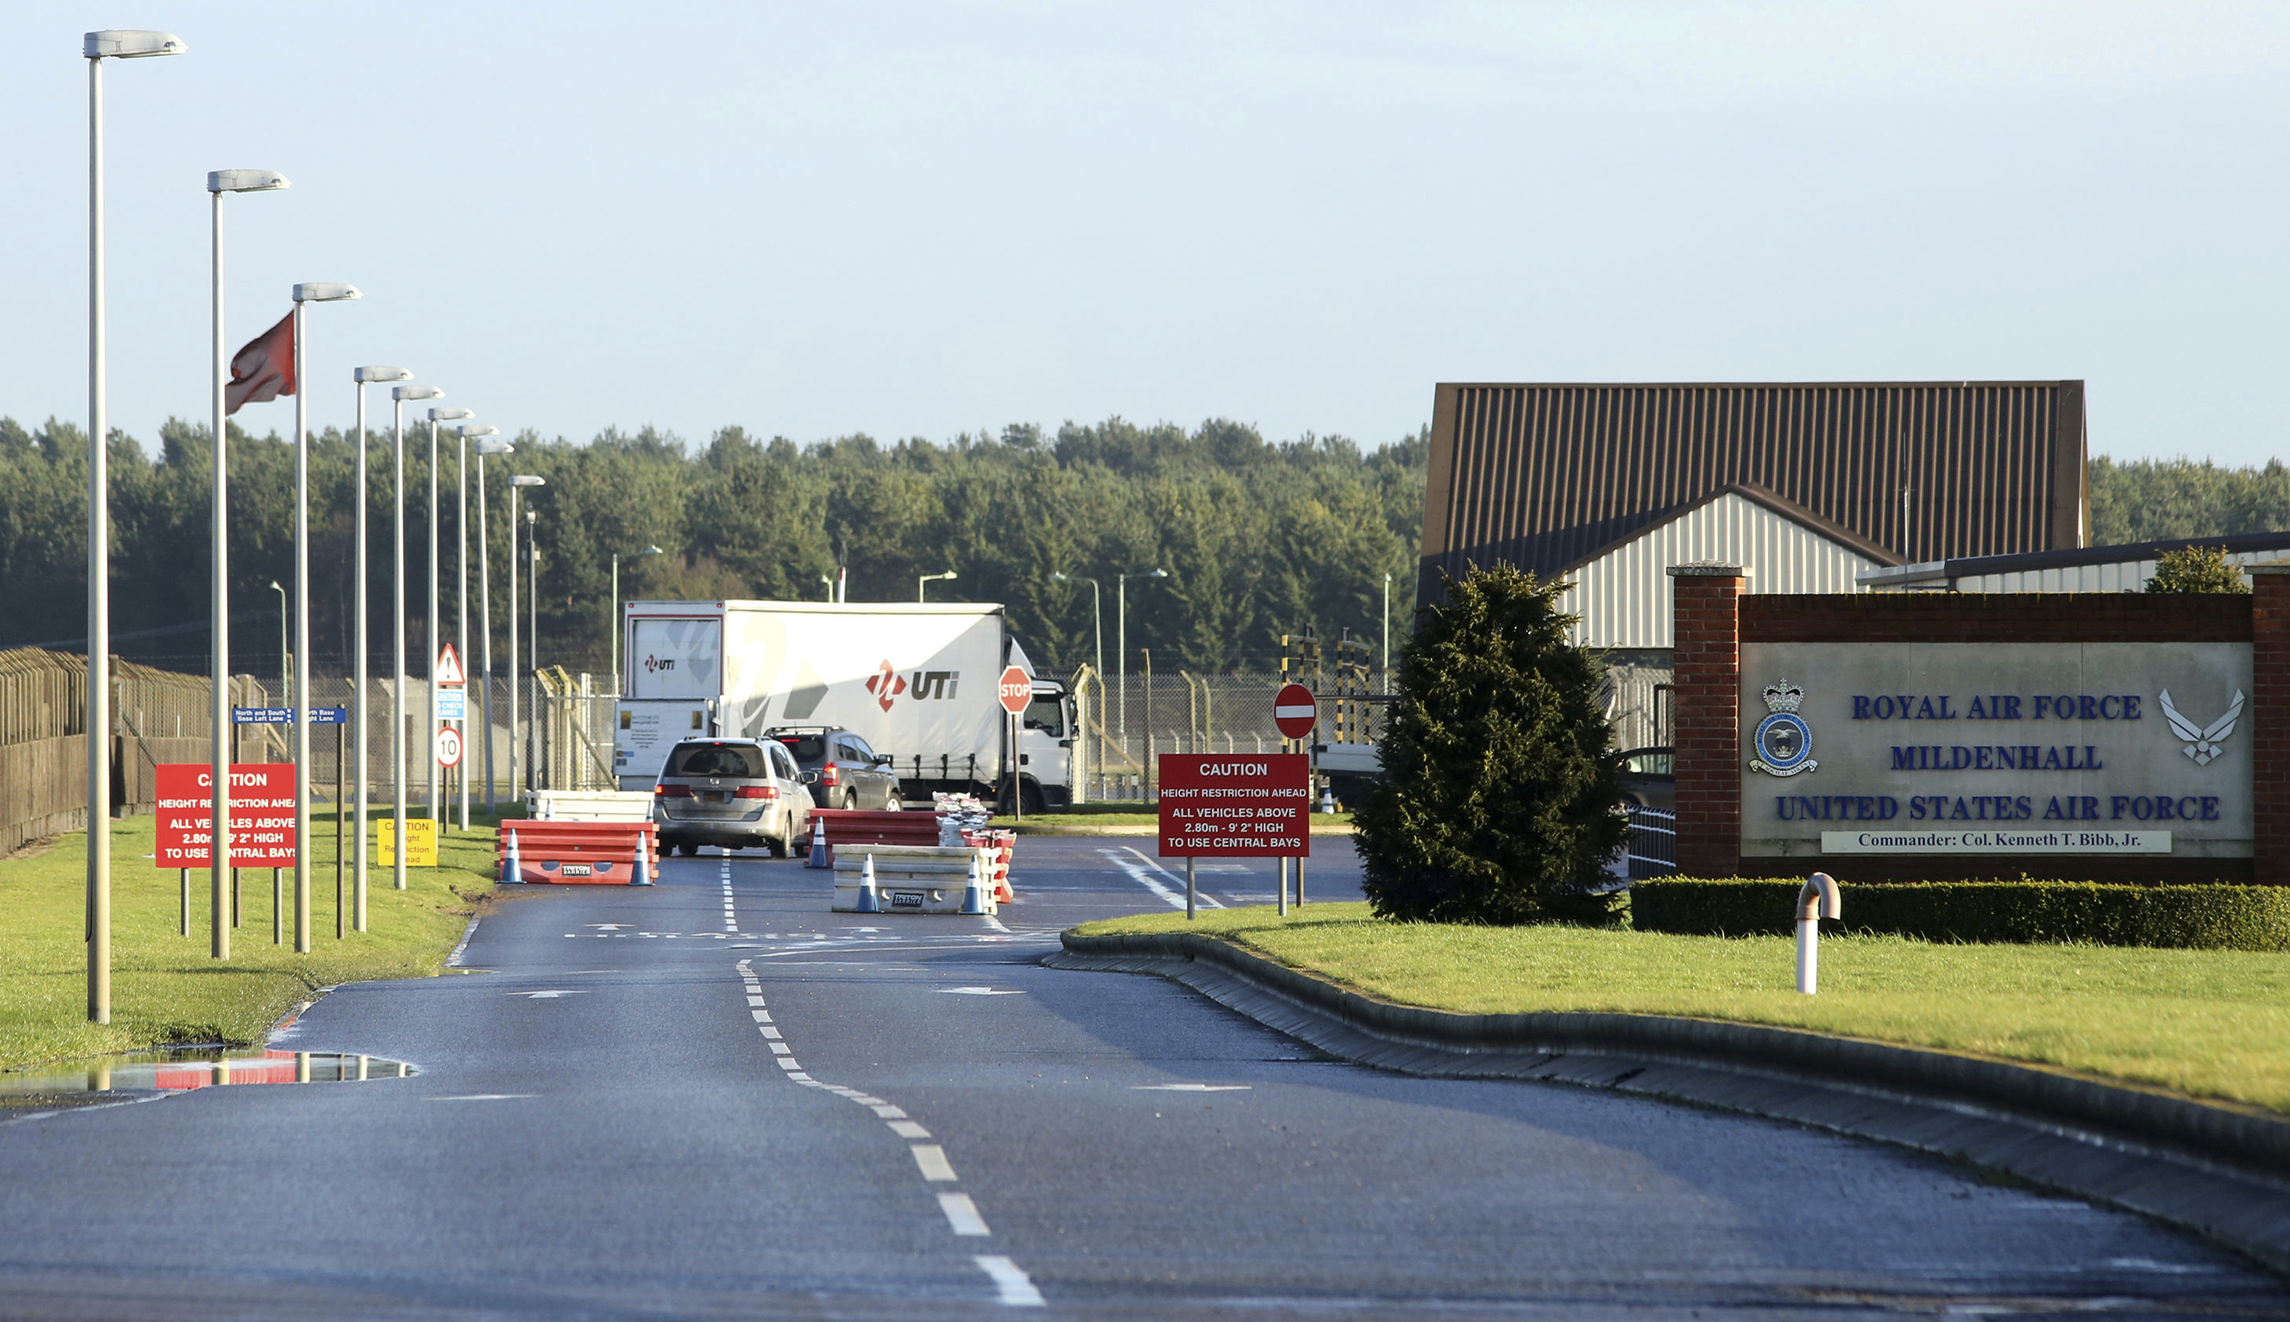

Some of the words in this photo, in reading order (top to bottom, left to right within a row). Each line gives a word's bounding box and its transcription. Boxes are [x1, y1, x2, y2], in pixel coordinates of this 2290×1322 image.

[659, 660, 675, 670] UTi
[911, 671, 959, 700] UTi
[1002, 684, 1029, 697] STOP
[1852, 695, 1956, 720] ROYAL
[1966, 695, 2022, 720] AIR
[2033, 695, 2141, 720] FORCE
[441, 740, 456, 755] 10
[1890, 745, 2103, 771] MILDENHALL
[1200, 764, 1267, 776] CAUTION
[198, 774, 267, 786] CTION
[1161, 789, 1199, 797] HEIGHT
[1202, 789, 1269, 797] RESTRICTION
[1271, 789, 1306, 797] AHEAD
[158, 799, 197, 808] HEIGHT
[200, 799, 269, 808] RERICTION
[271, 799, 295, 808] AHEA
[1776, 796, 1898, 821] UNITED
[1910, 796, 2031, 821] STATES
[2043, 796, 2100, 821] AIR
[2110, 796, 2220, 821] FORCE
[1173, 808, 1194, 817] ALL
[1197, 808, 1253, 817] VEHICLES
[1256, 808, 1296, 817] ABOVE
[170, 819, 192, 828] ALL
[195, 818, 252, 828] VELES
[255, 818, 295, 828] ABOVE
[384, 822, 429, 831] CTION
[1185, 823, 1218, 832] 2.80m
[1228, 823, 1238, 832] 9'
[1241, 823, 1251, 832] 2"
[1255, 823, 1284, 832] HIGH
[239, 833, 251, 843] 2"
[254, 833, 284, 843] HIGH
[405, 835, 420, 843] ight
[1168, 838, 1184, 847] TO
[1187, 838, 1210, 847] USE
[1213, 838, 1267, 847] CENTRAL
[1270, 838, 1301, 847] BAYS
[1859, 833, 1957, 846] Commander:
[1962, 833, 1992, 846] Col.
[1996, 833, 2057, 846] Kenneth
[2061, 833, 2075, 846] T.
[2080, 833, 2118, 848] Bibb,
[2122, 833, 2141, 846] Jr.
[165, 849, 182, 858] TO
[185, 849, 209, 858] USE
[228, 848, 266, 858] NTRAL
